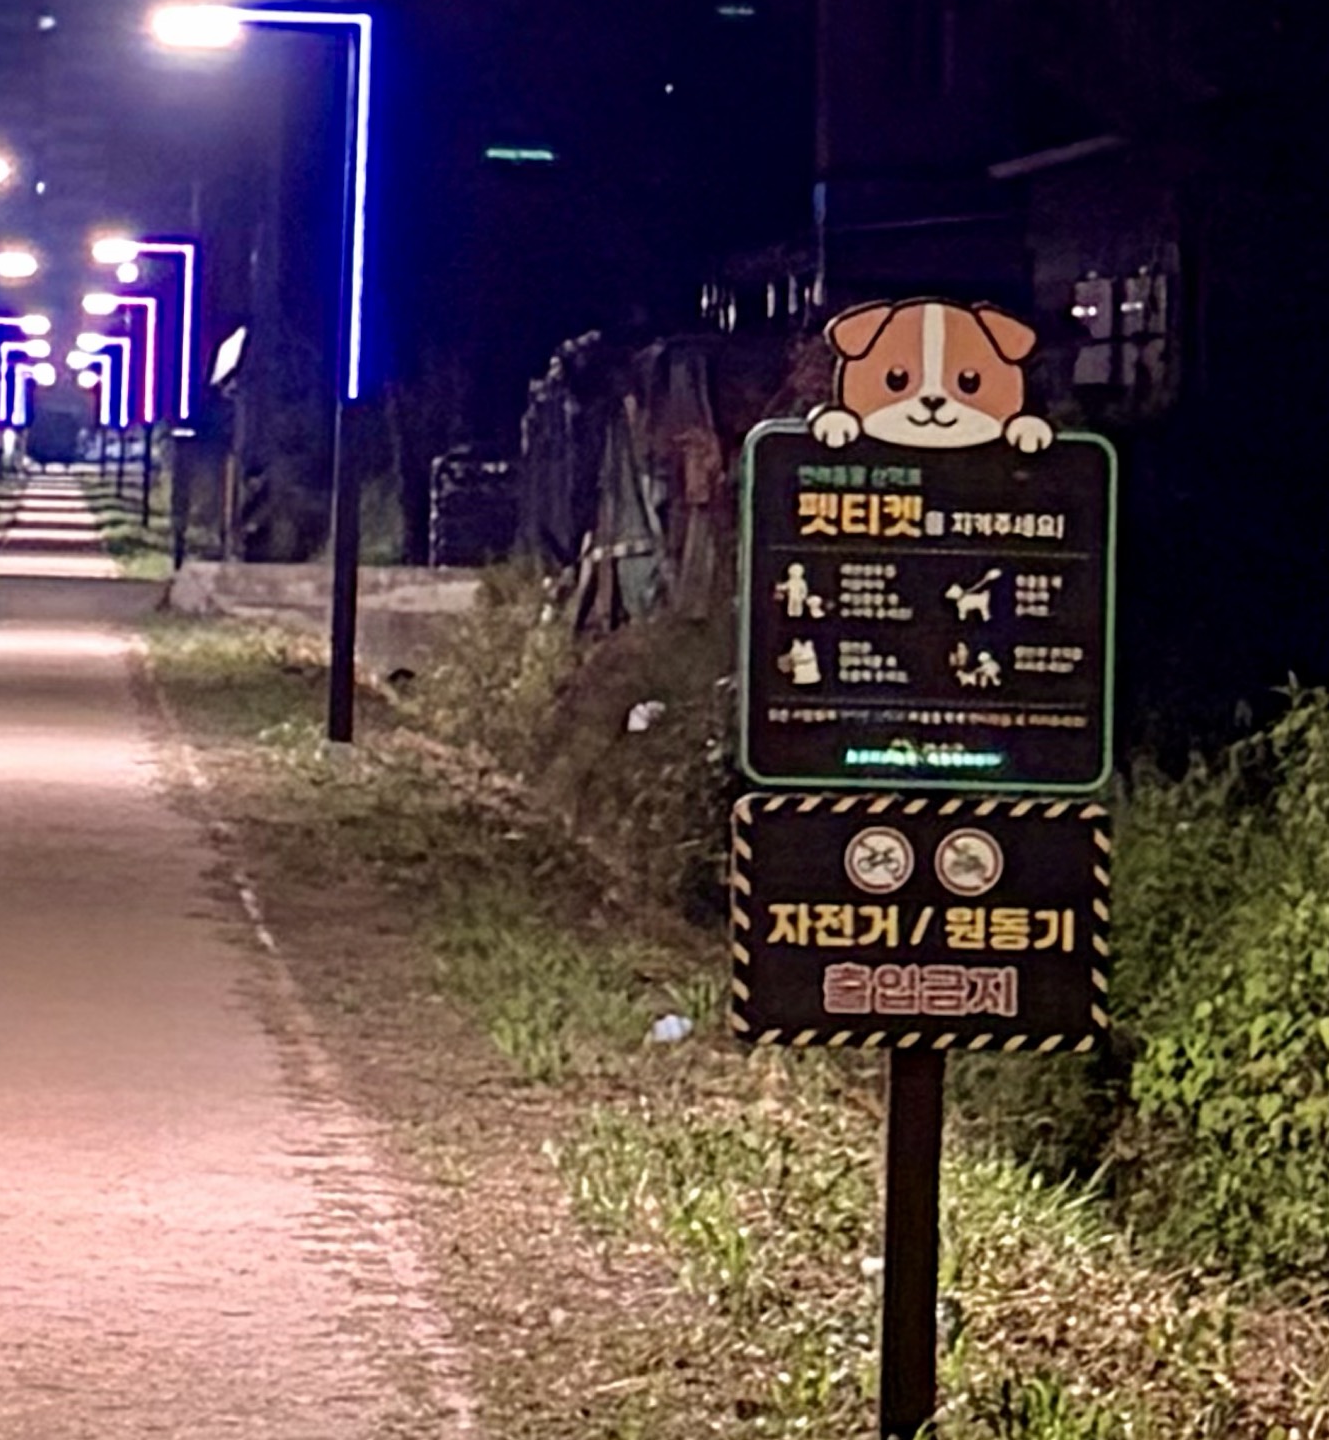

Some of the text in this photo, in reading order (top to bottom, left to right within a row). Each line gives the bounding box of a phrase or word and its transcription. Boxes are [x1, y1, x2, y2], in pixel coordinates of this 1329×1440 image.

[798, 492, 945, 538] 펫티켓
[766, 902, 1075, 952] 자전거 / 원동기
[822, 962, 1019, 1017] 출입금지
